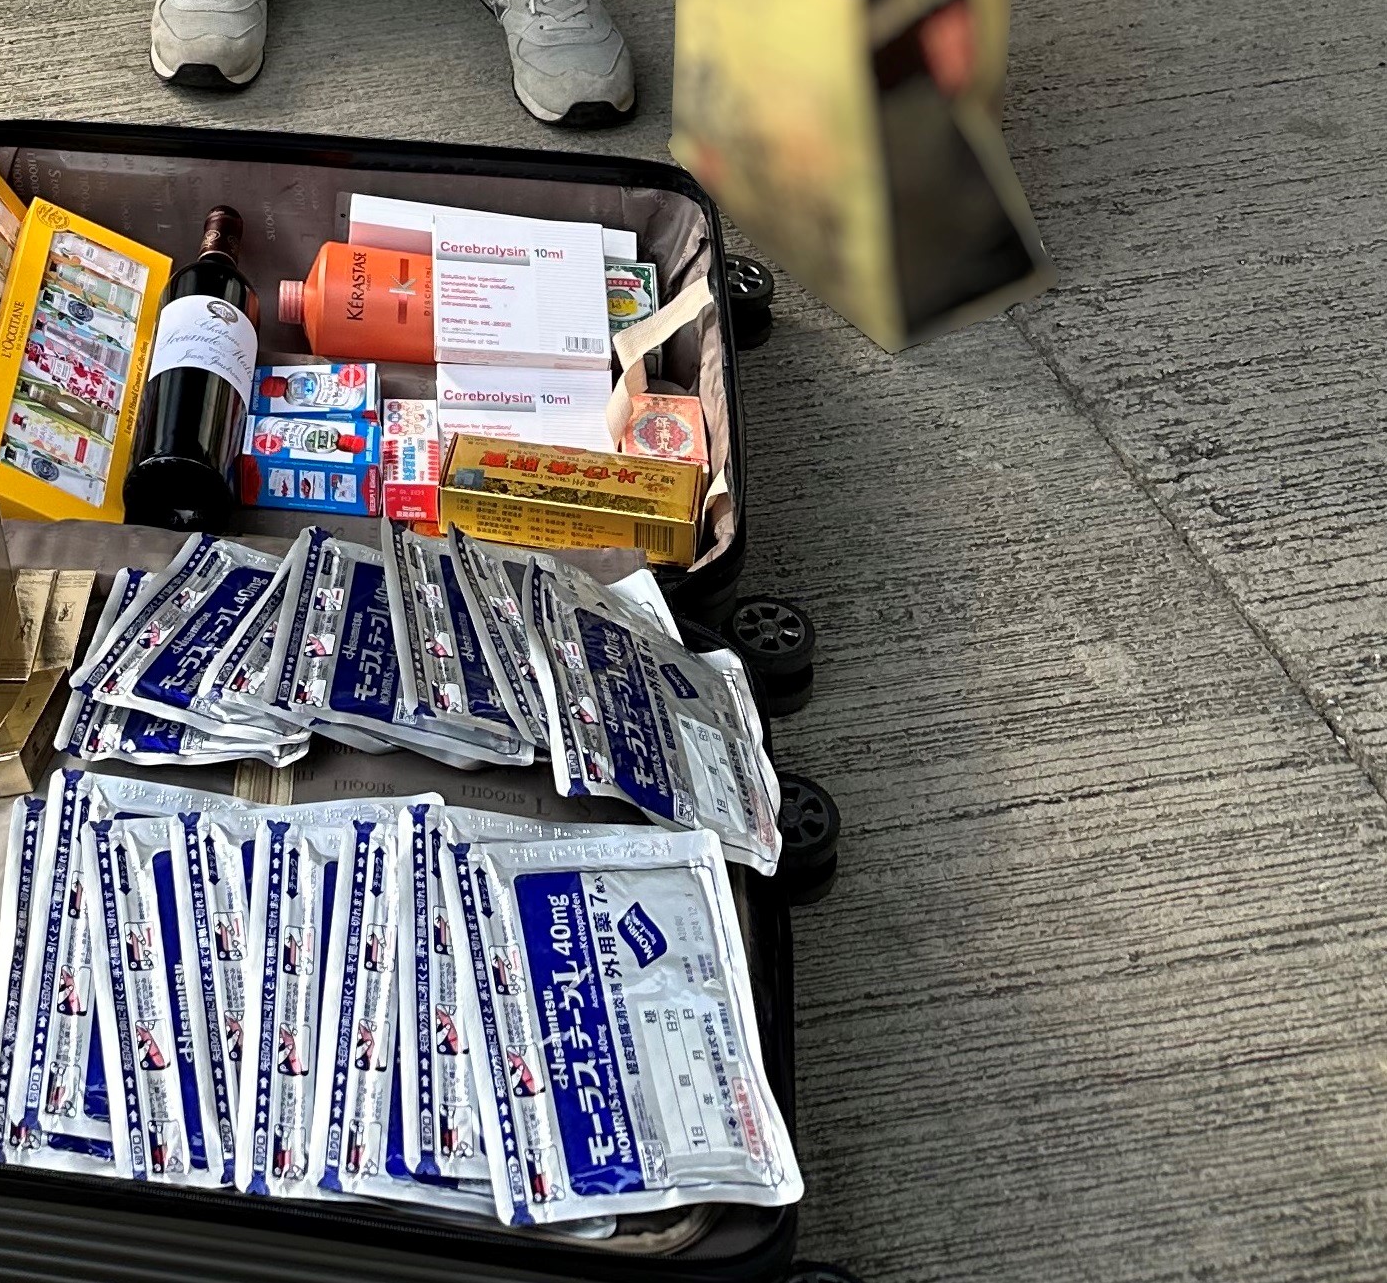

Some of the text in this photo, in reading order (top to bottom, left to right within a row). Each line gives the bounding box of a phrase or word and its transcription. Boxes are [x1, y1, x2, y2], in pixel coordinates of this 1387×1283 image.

[534, 248, 564, 260] 10ml
[346, 252, 367, 322] KÉRASTASE
[1, 301, 25, 358] L'OCCITANE
[443, 389, 571, 406] Cerebrolysin 10ml
[547, 893, 574, 957] 40mg
[624, 915, 654, 960] MOHRUS
[664, 1007, 678, 1032] 日分
[683, 1008, 695, 1020] 日
[542, 987, 569, 1091] Hisamitsu
[692, 1049, 705, 1061] 月
[608, 1098, 633, 1164] MOHRUS
[691, 1125, 706, 1146] 1日
